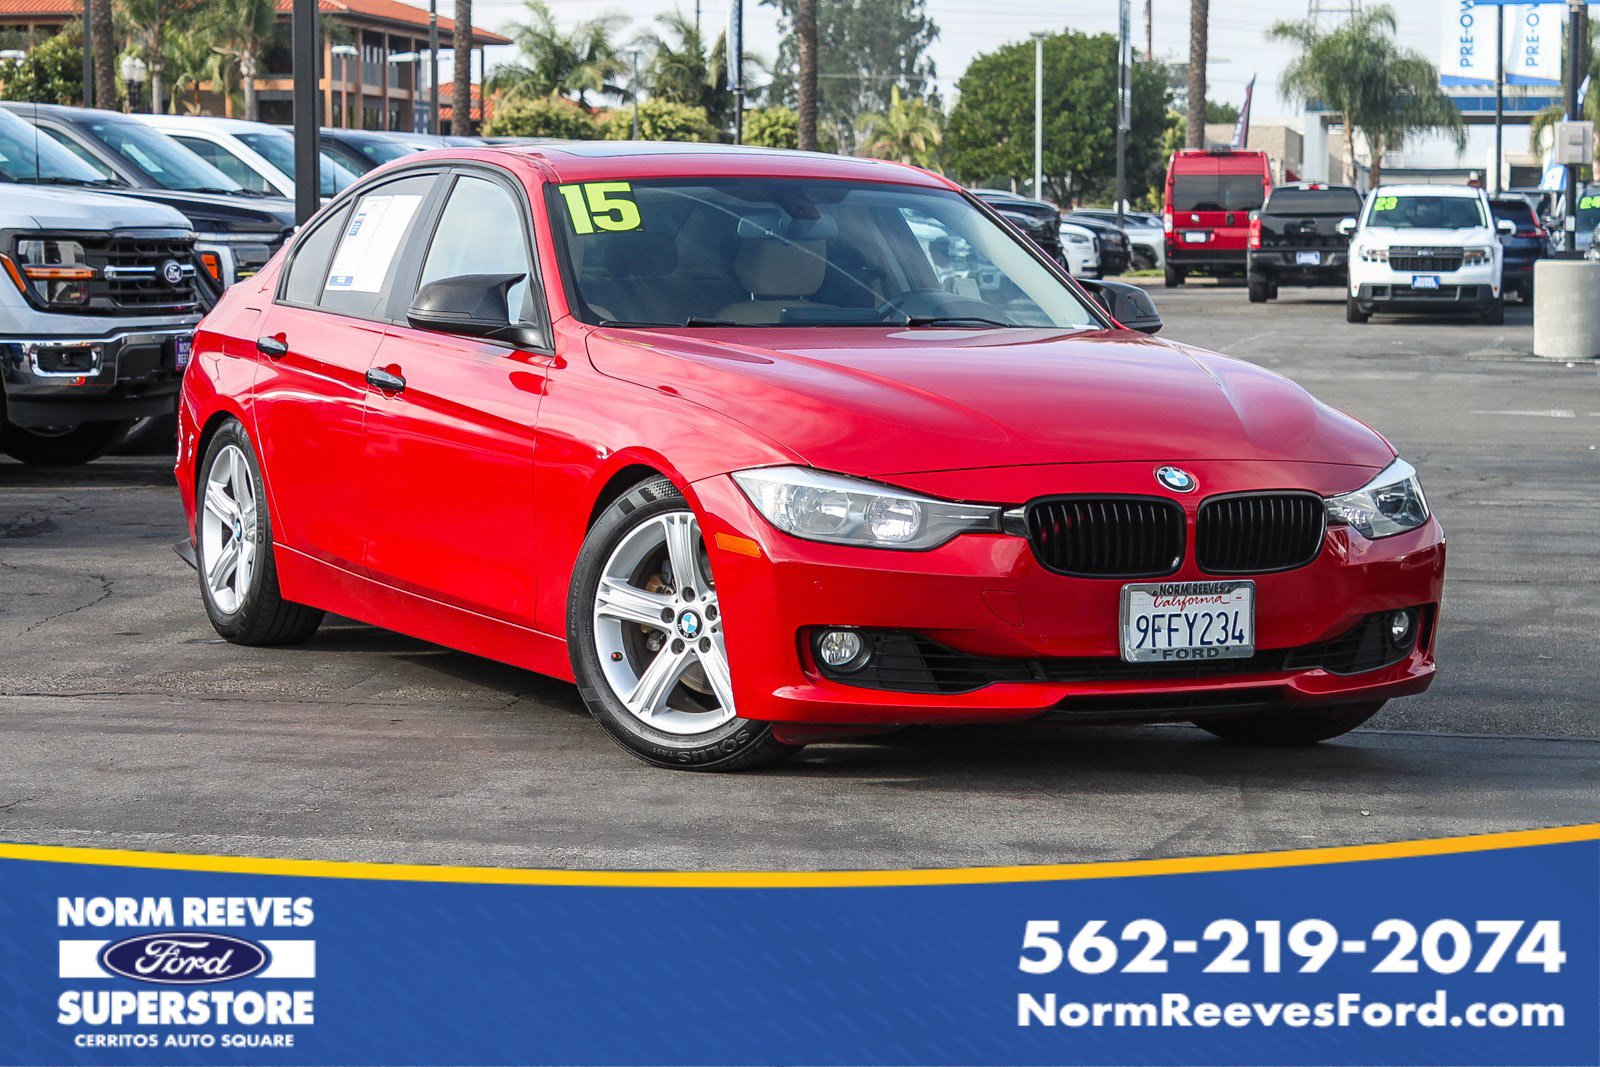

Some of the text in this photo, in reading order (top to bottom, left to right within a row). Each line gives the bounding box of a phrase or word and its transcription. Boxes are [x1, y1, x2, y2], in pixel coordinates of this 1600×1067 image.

[558, 182, 641, 234] 15
[1374, 196, 1398, 211] 23
[1160, 581, 1224, 596] NORM REEVES
[1153, 595, 1231, 612] California
[1135, 610, 1245, 649] 9FFY234
[1162, 647, 1220, 660] FORD
[677, 729, 751, 762] SOLUS
